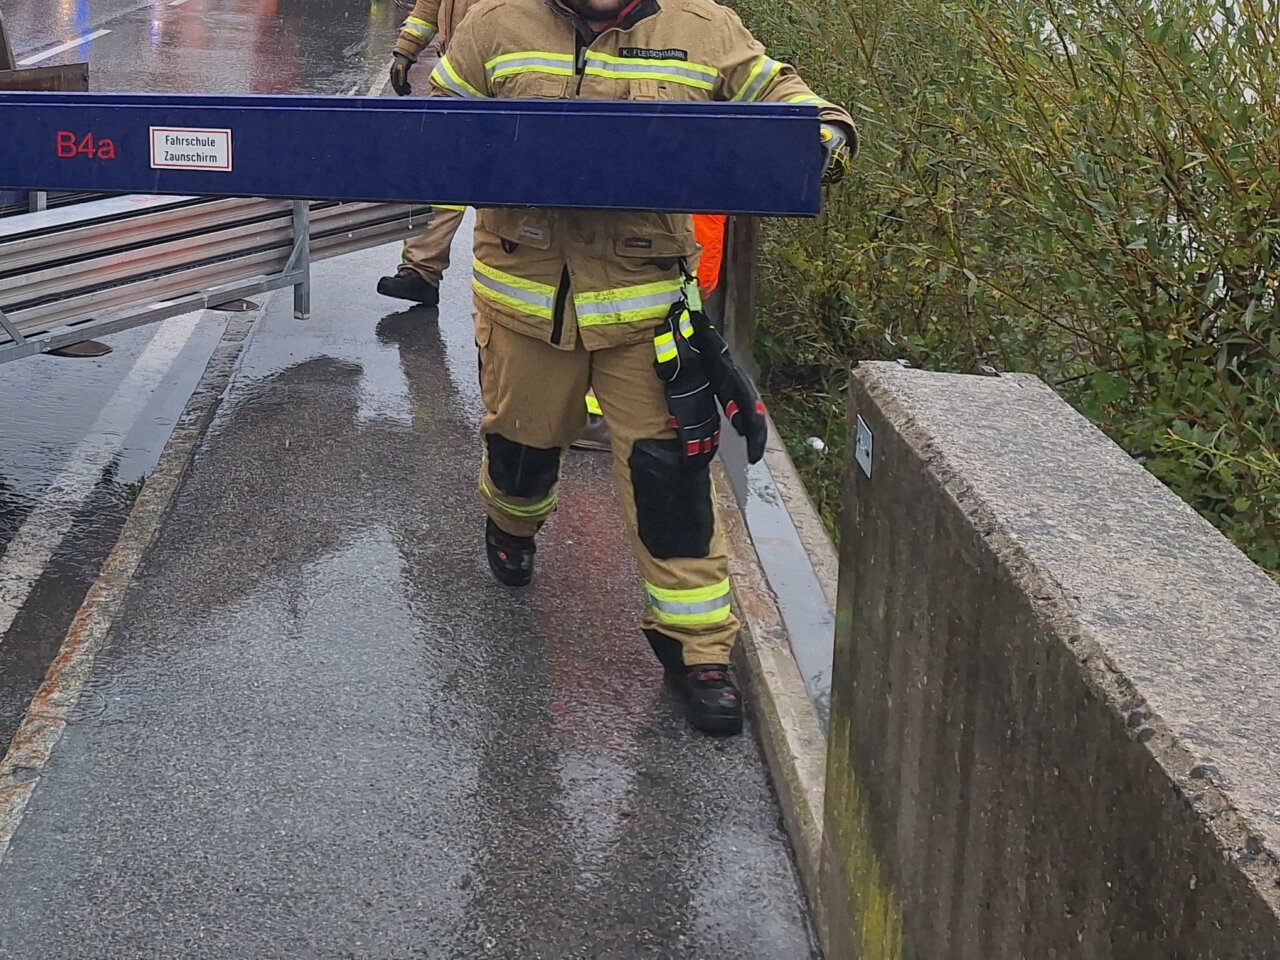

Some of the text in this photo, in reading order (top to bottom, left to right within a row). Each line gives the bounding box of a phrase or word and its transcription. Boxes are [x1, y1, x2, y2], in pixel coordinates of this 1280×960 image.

[56, 131, 116, 160] B4a
[165, 135, 216, 147] Fahrschule
[164, 151, 218, 163] Zaunschirm
